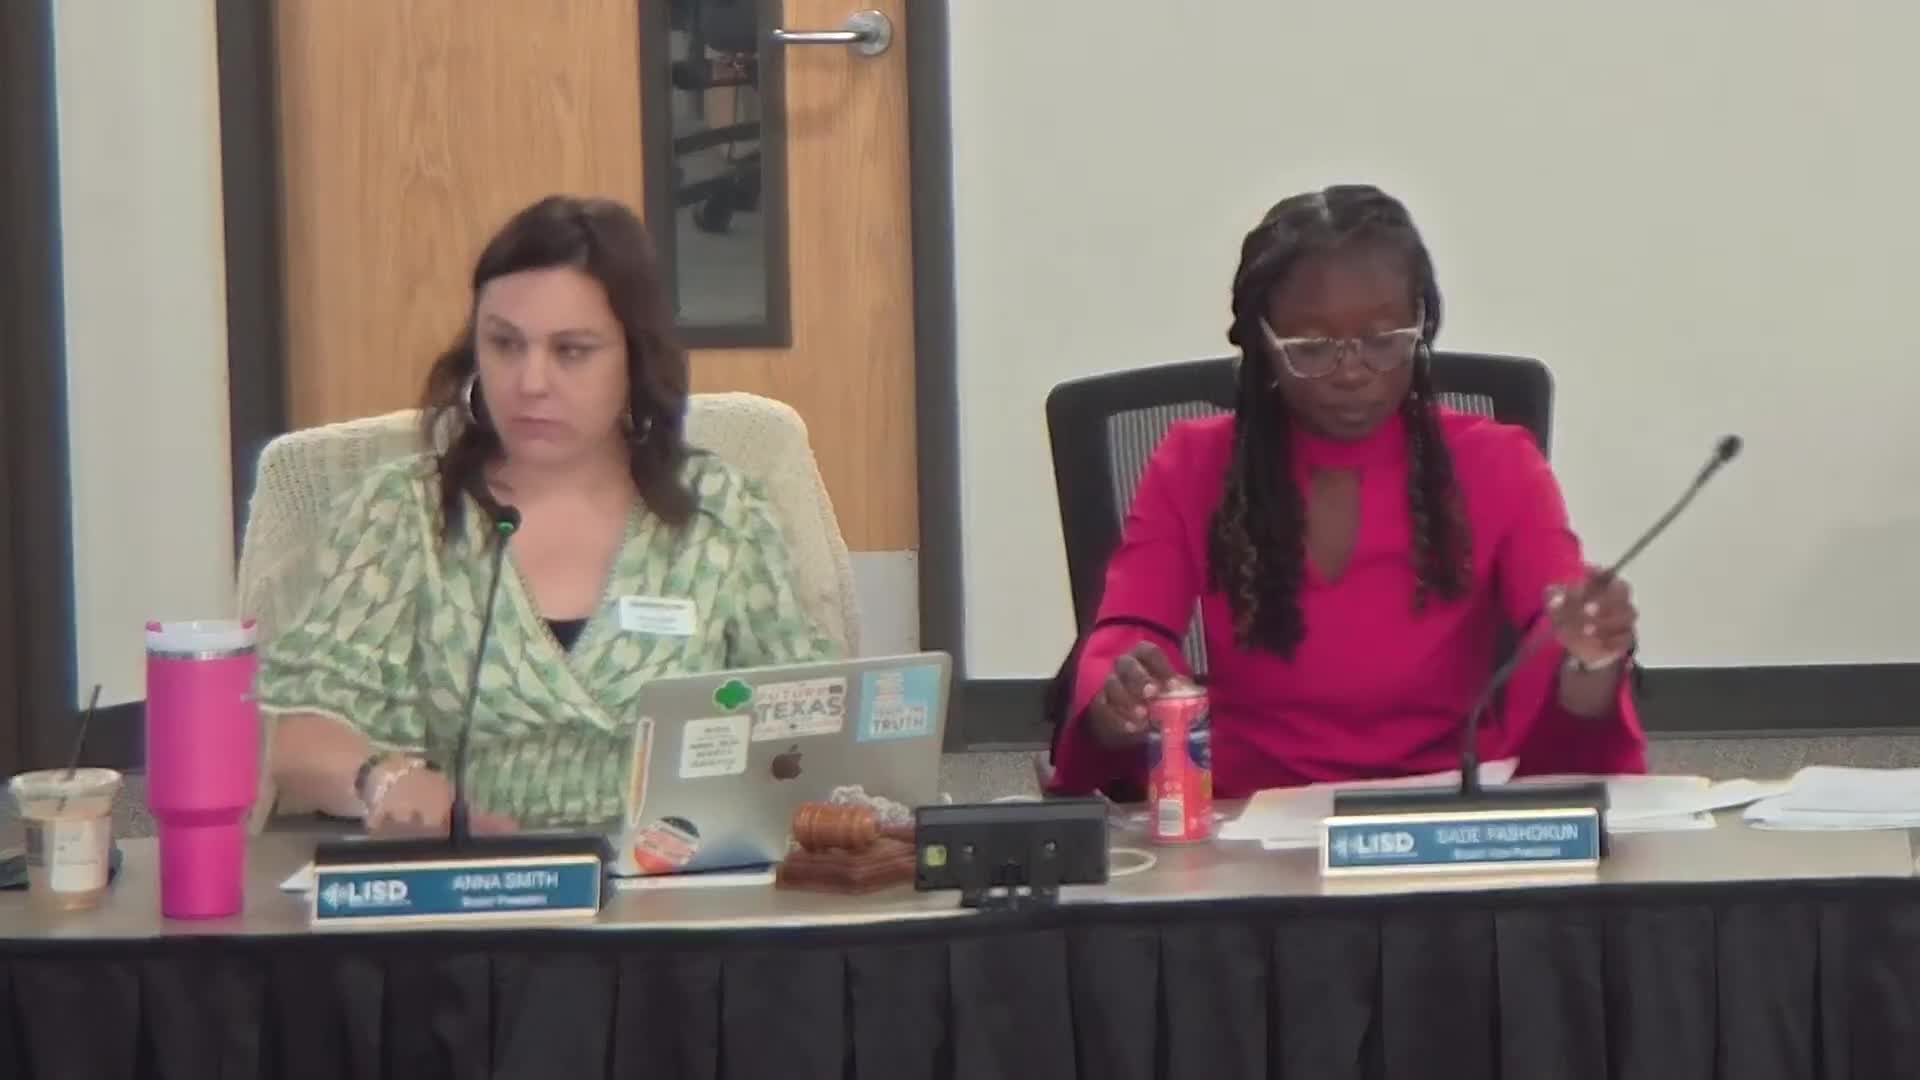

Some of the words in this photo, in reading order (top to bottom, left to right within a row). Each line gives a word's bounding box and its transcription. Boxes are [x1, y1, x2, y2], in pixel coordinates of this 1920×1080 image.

[757, 697, 843, 722] TEXAS
[1357, 831, 1414, 853] LISD
[349, 879, 408, 902] LISD
[504, 871, 558, 889] SMITH
